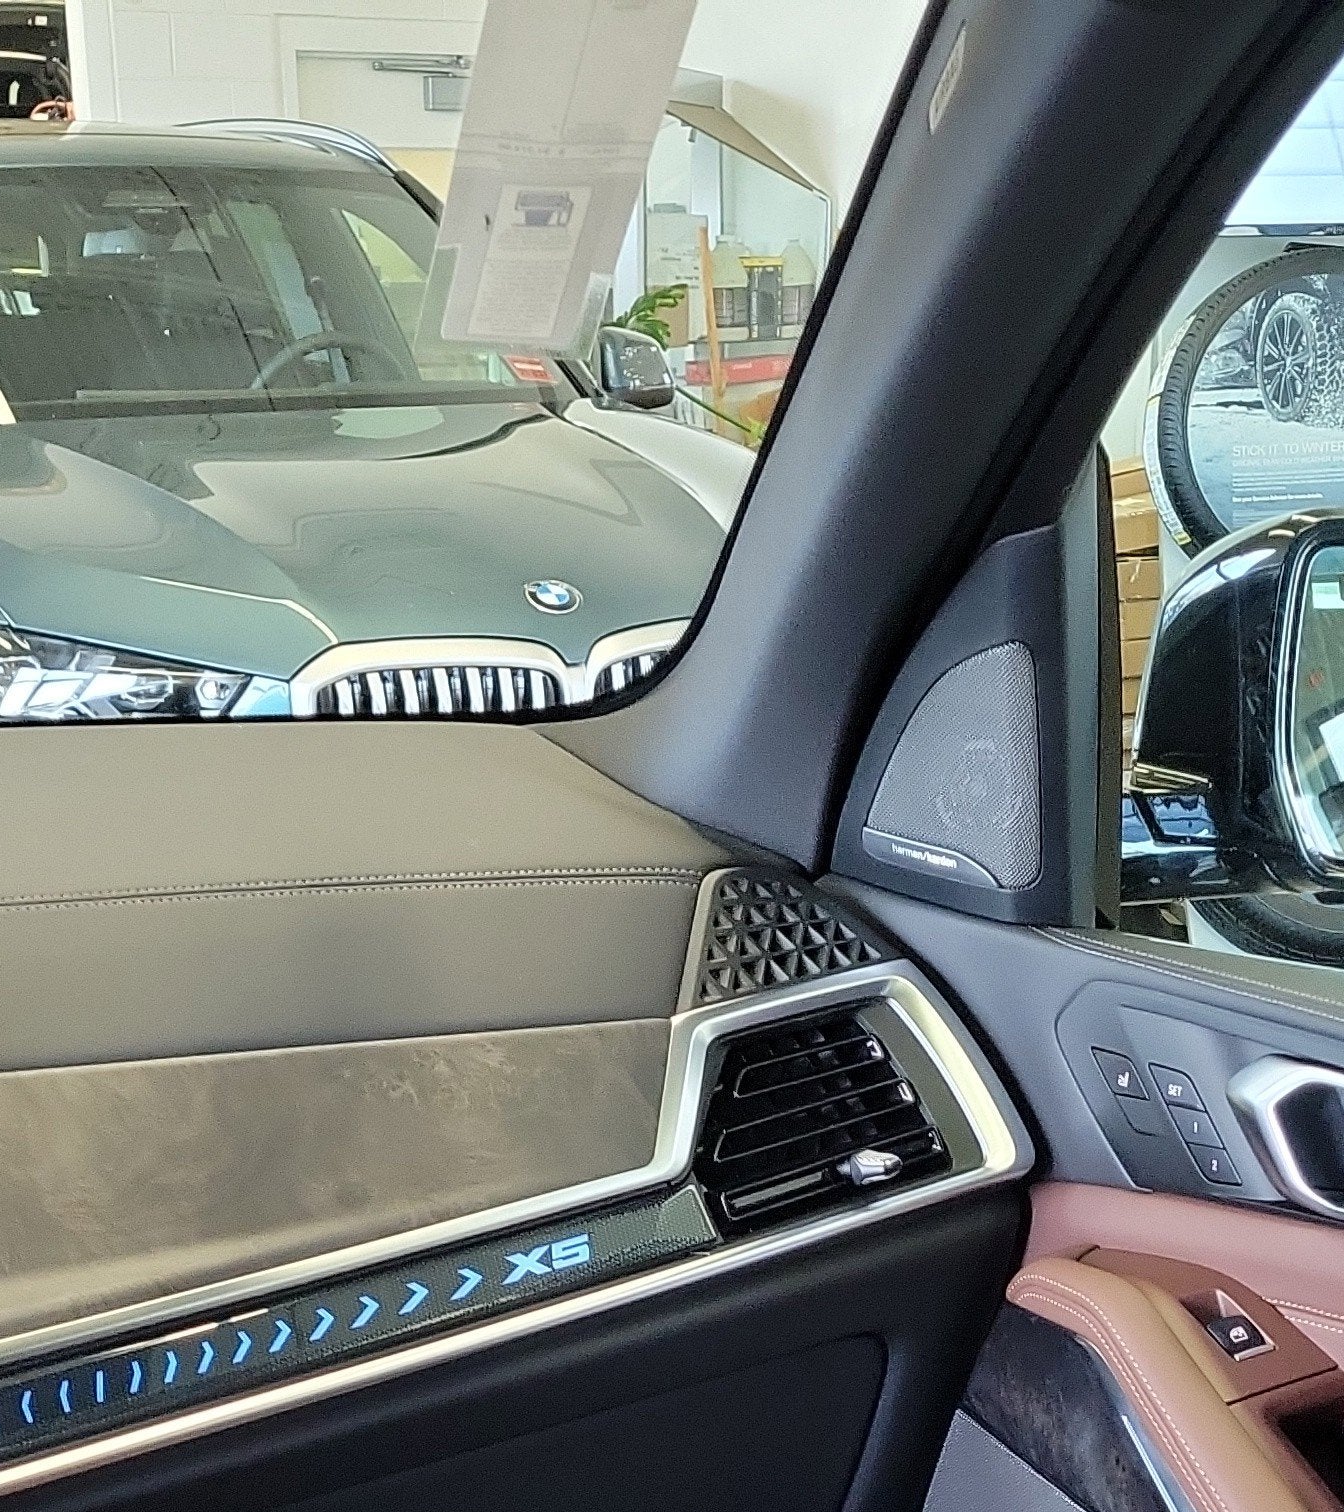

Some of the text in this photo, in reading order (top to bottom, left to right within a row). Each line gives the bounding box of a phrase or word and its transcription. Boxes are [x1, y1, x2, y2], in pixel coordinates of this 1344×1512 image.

[1232, 443, 1268, 457] STICK
[1269, 444, 1278, 455] IT
[1284, 444, 1299, 455] TO
[1167, 1083, 1183, 1097] SET
[1211, 1159, 1218, 1171] 2
[502, 1233, 590, 1286] X5
